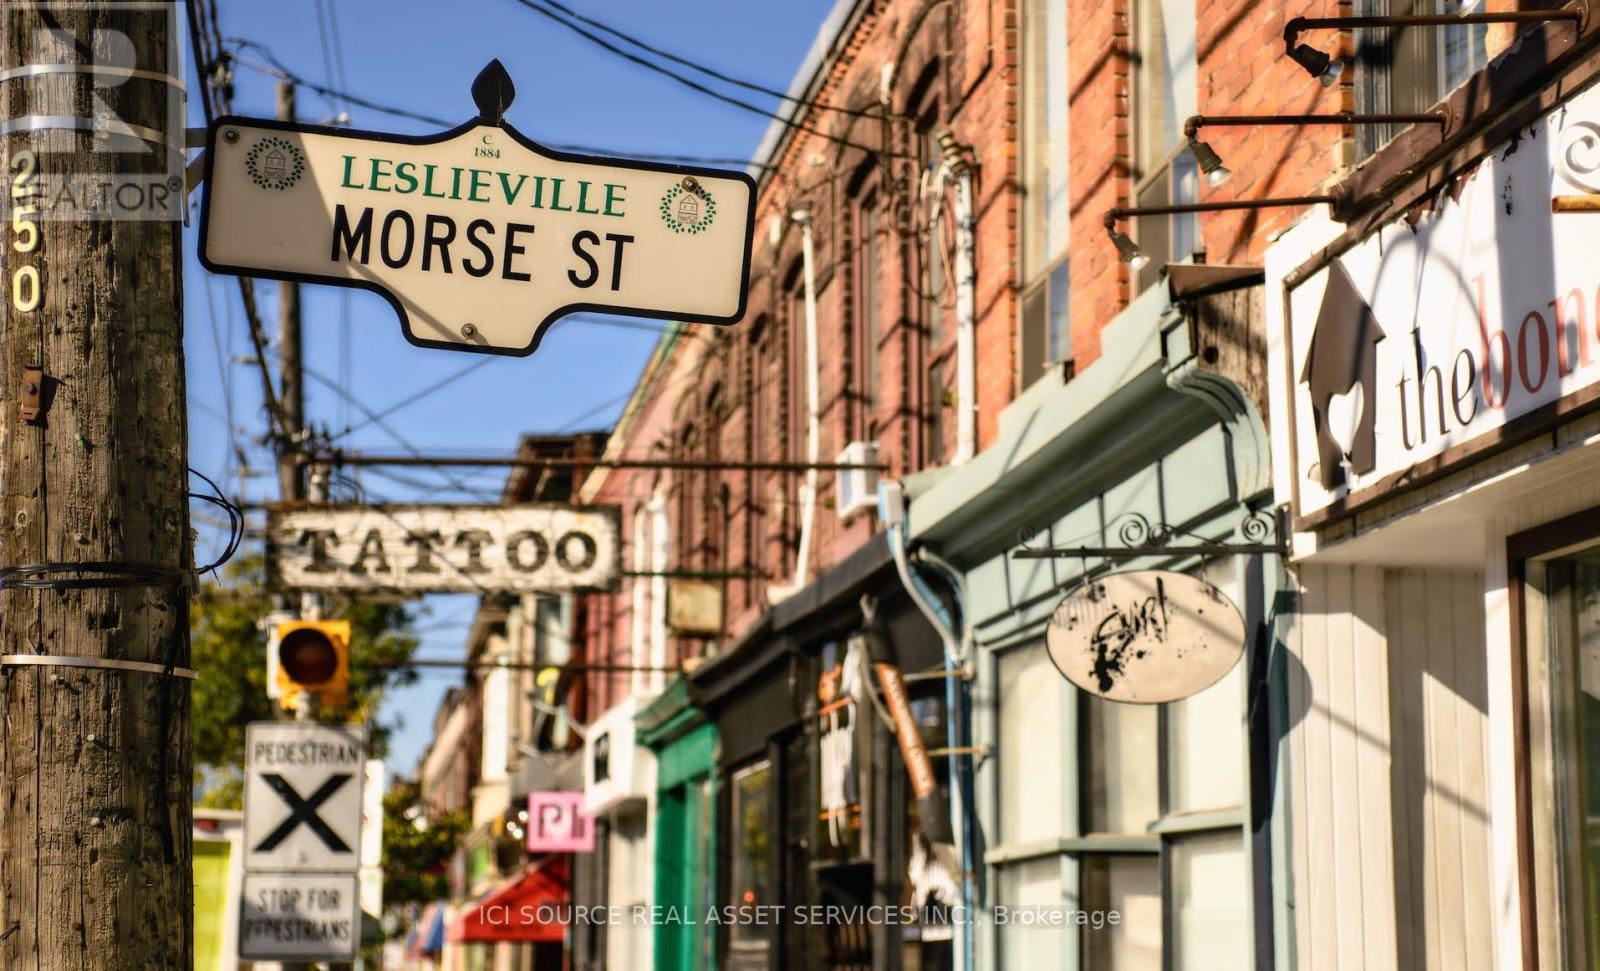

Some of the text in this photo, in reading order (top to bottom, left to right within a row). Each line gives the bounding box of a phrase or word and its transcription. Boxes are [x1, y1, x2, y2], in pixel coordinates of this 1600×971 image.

[474, 147, 501, 159] 1884
[341, 155, 628, 217] LESLIEVILLE
[331, 204, 635, 291] MORSE ST
[297, 528, 597, 574] TATTOO
[254, 742, 358, 766] PEDESTRIAN
[257, 887, 341, 913] STOP FOR
